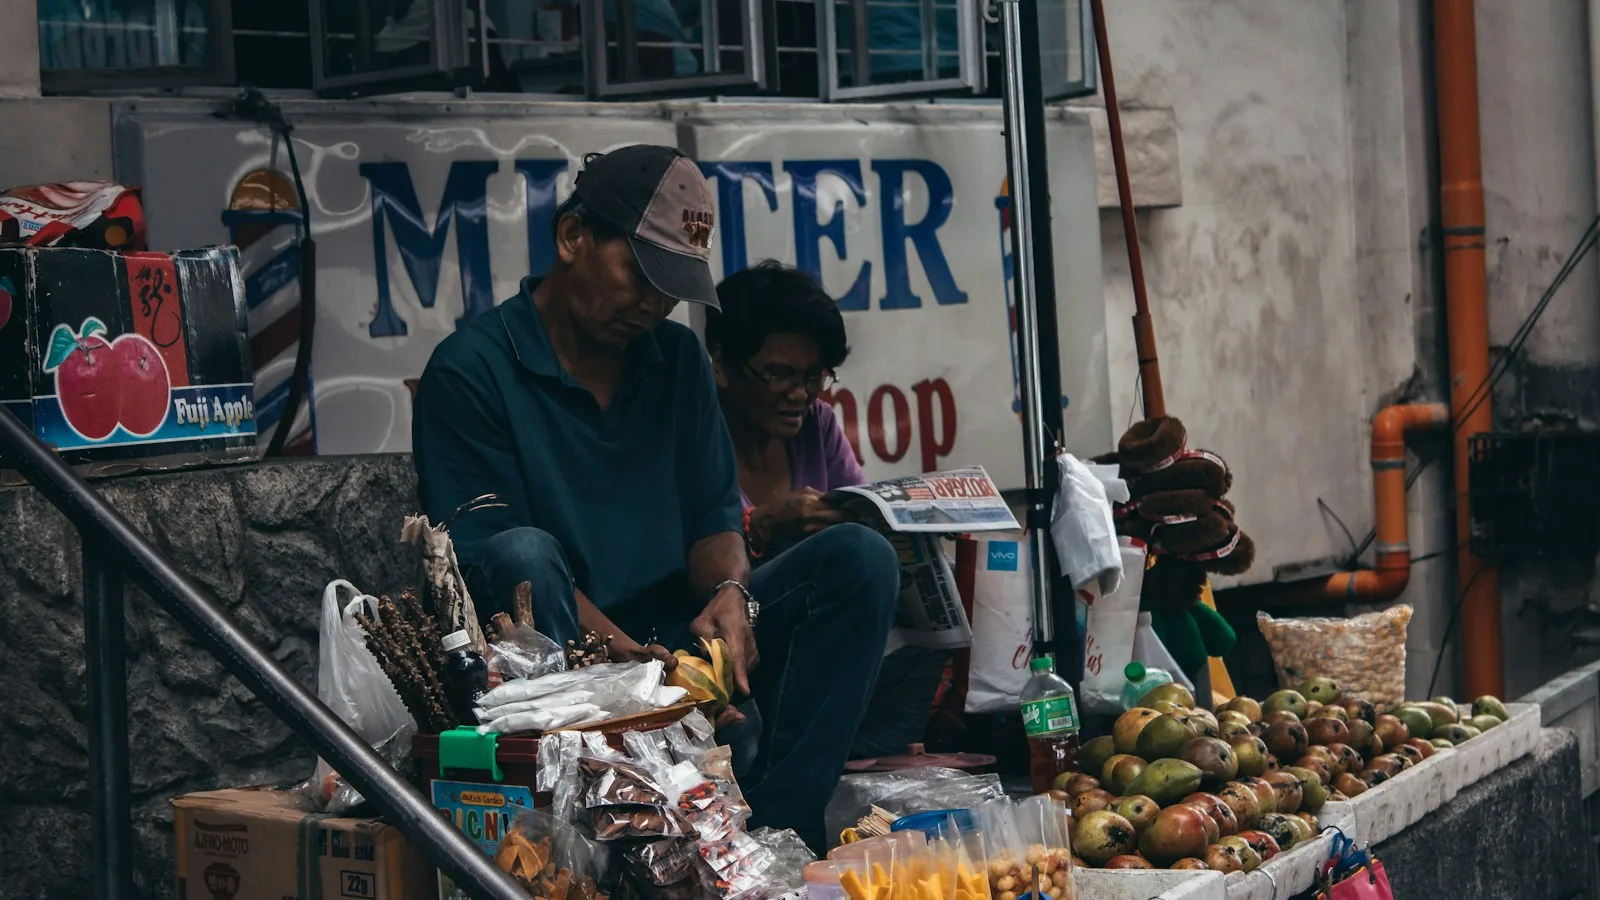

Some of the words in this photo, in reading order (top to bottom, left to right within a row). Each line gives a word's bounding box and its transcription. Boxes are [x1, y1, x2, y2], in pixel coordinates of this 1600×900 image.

[359, 158, 968, 338] MITER
[174, 396, 209, 430] Fuji
[214, 394, 253, 428] Apple
[991, 550, 1015, 559] vivo
[347, 874, 368, 895] 22g
